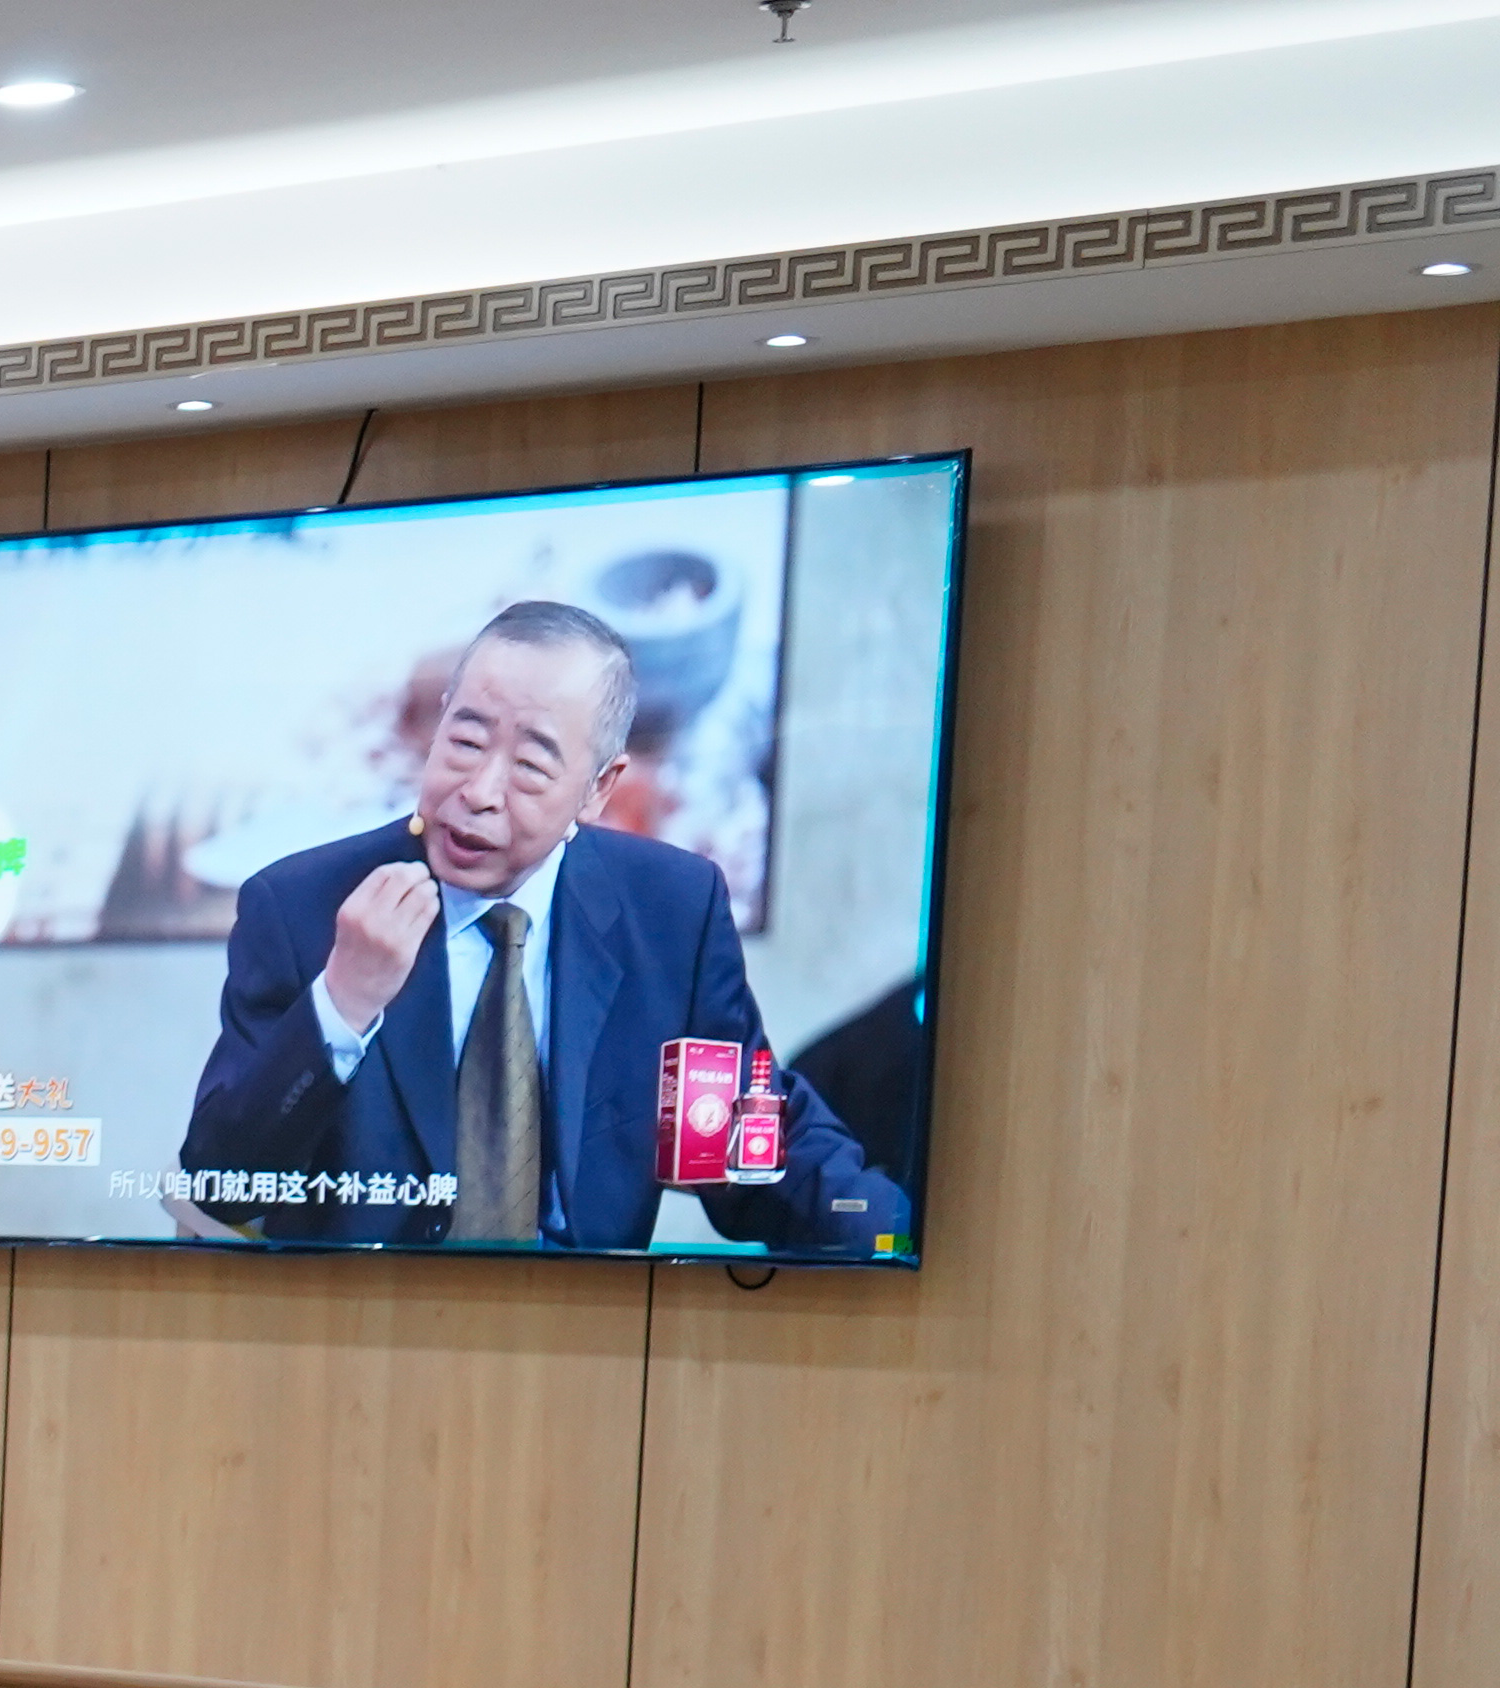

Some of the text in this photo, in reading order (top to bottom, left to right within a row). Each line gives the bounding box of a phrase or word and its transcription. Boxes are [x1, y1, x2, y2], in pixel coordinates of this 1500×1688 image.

[108, 1168, 459, 1207] 所以咱们就用这个补益心脾
